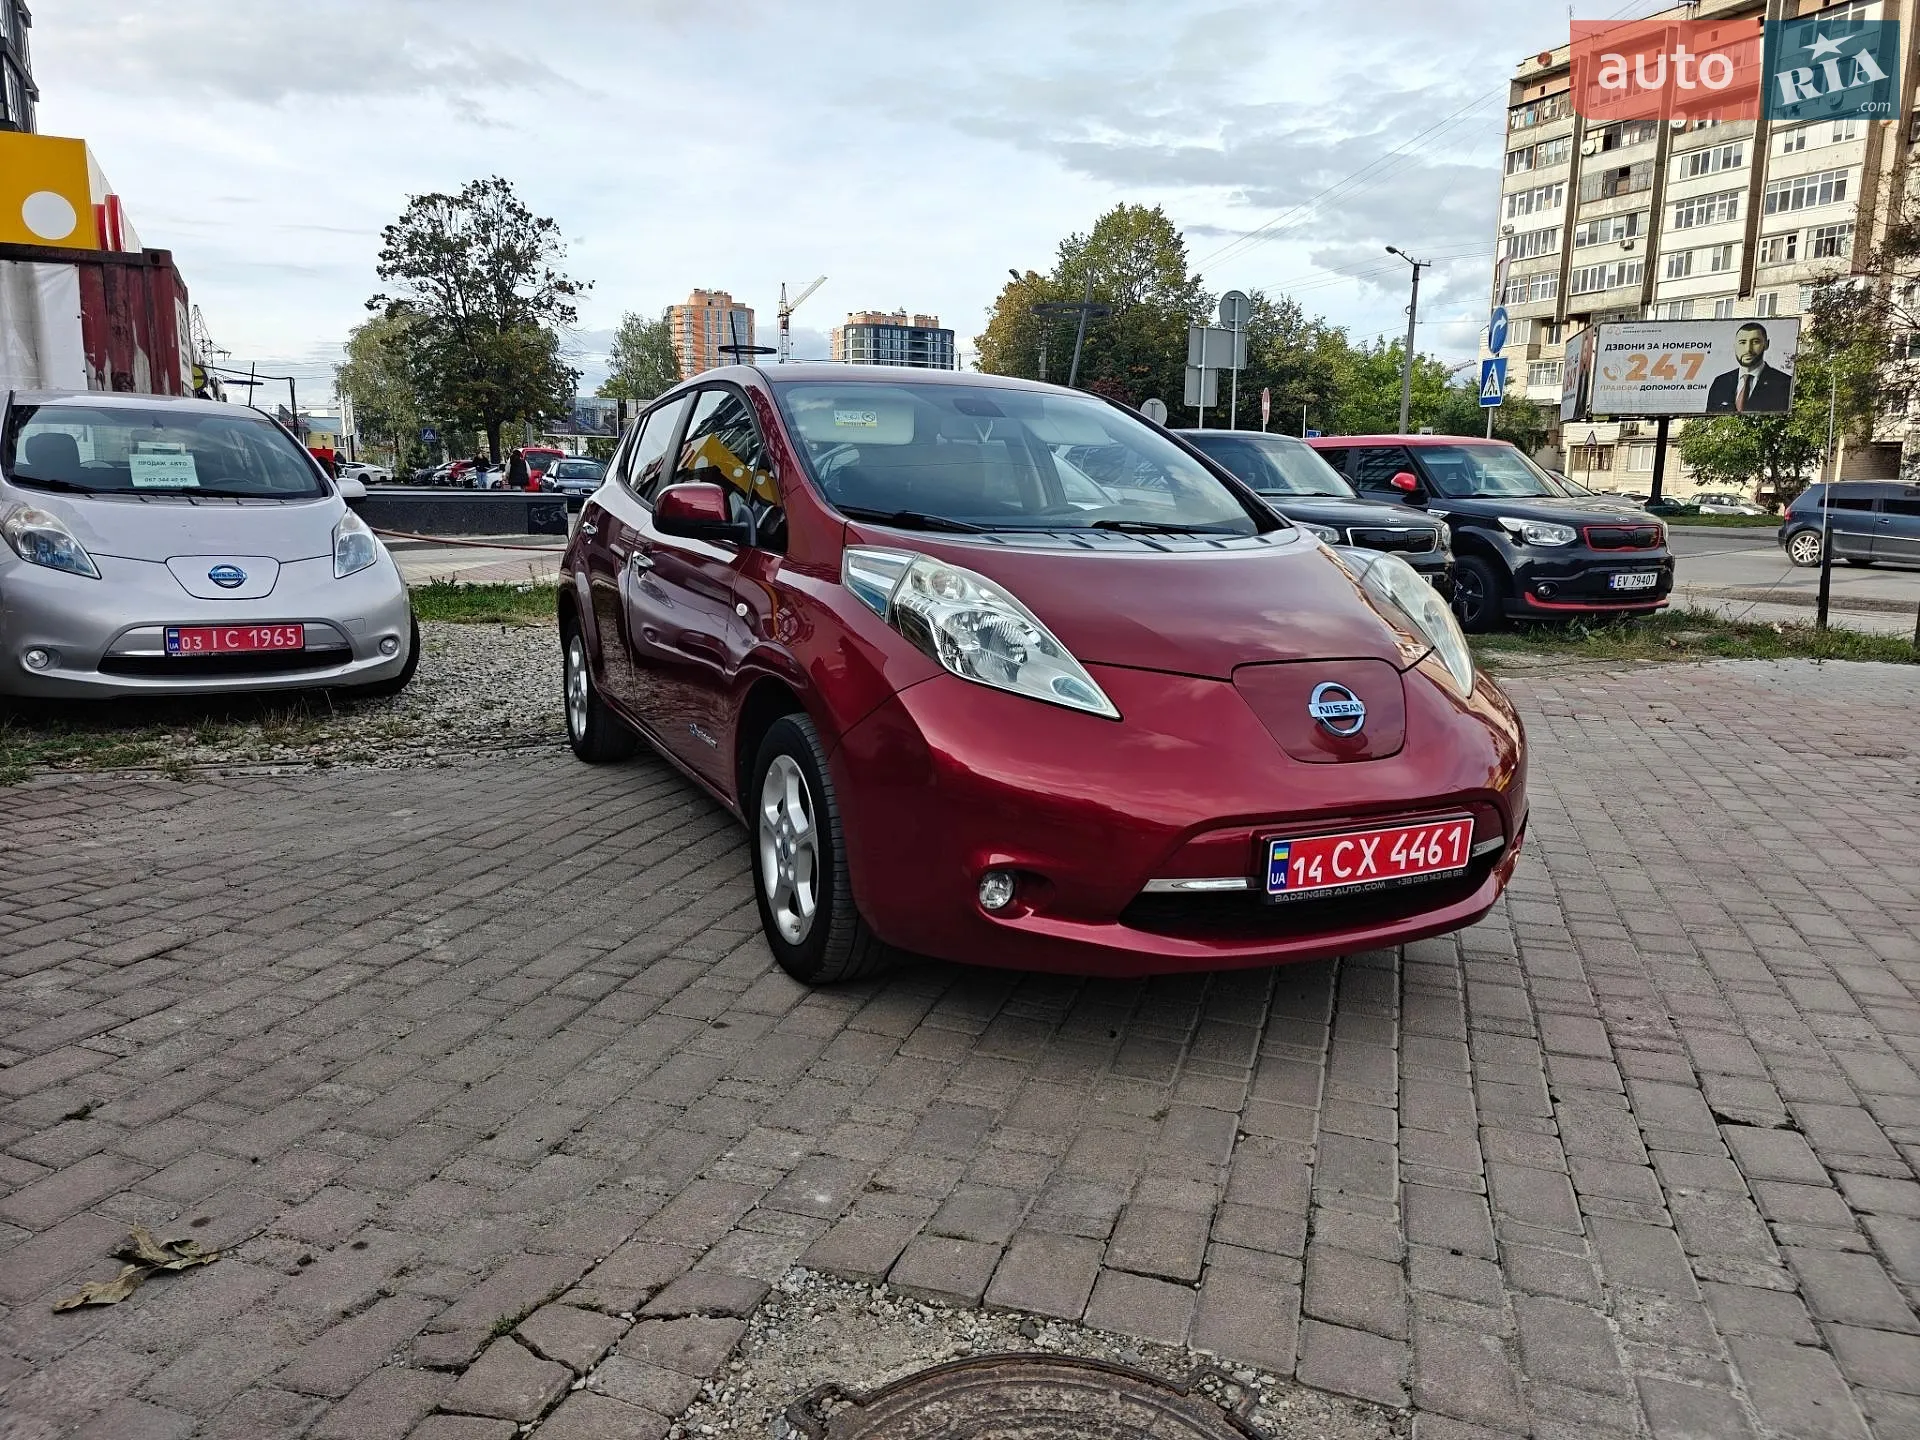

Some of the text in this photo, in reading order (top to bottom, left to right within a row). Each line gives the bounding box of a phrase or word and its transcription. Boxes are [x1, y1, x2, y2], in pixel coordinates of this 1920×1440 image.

[1604, 341, 1712, 352] ДЗВОНИ ЗА НОМЕРОМ
[1625, 352, 1705, 382] 247
[1639, 383, 1685, 392] ДОПОМОГА
[1687, 383, 1708, 391] ВСІМ
[1616, 574, 1656, 587] EV 79407
[182, 636, 202, 650] 03
[248, 628, 296, 648] 1965
[169, 642, 179, 650] UA
[1318, 703, 1364, 715] NISSAN
[1292, 826, 1462, 886] 14 CX 4461
[1271, 872, 1286, 885] UA
